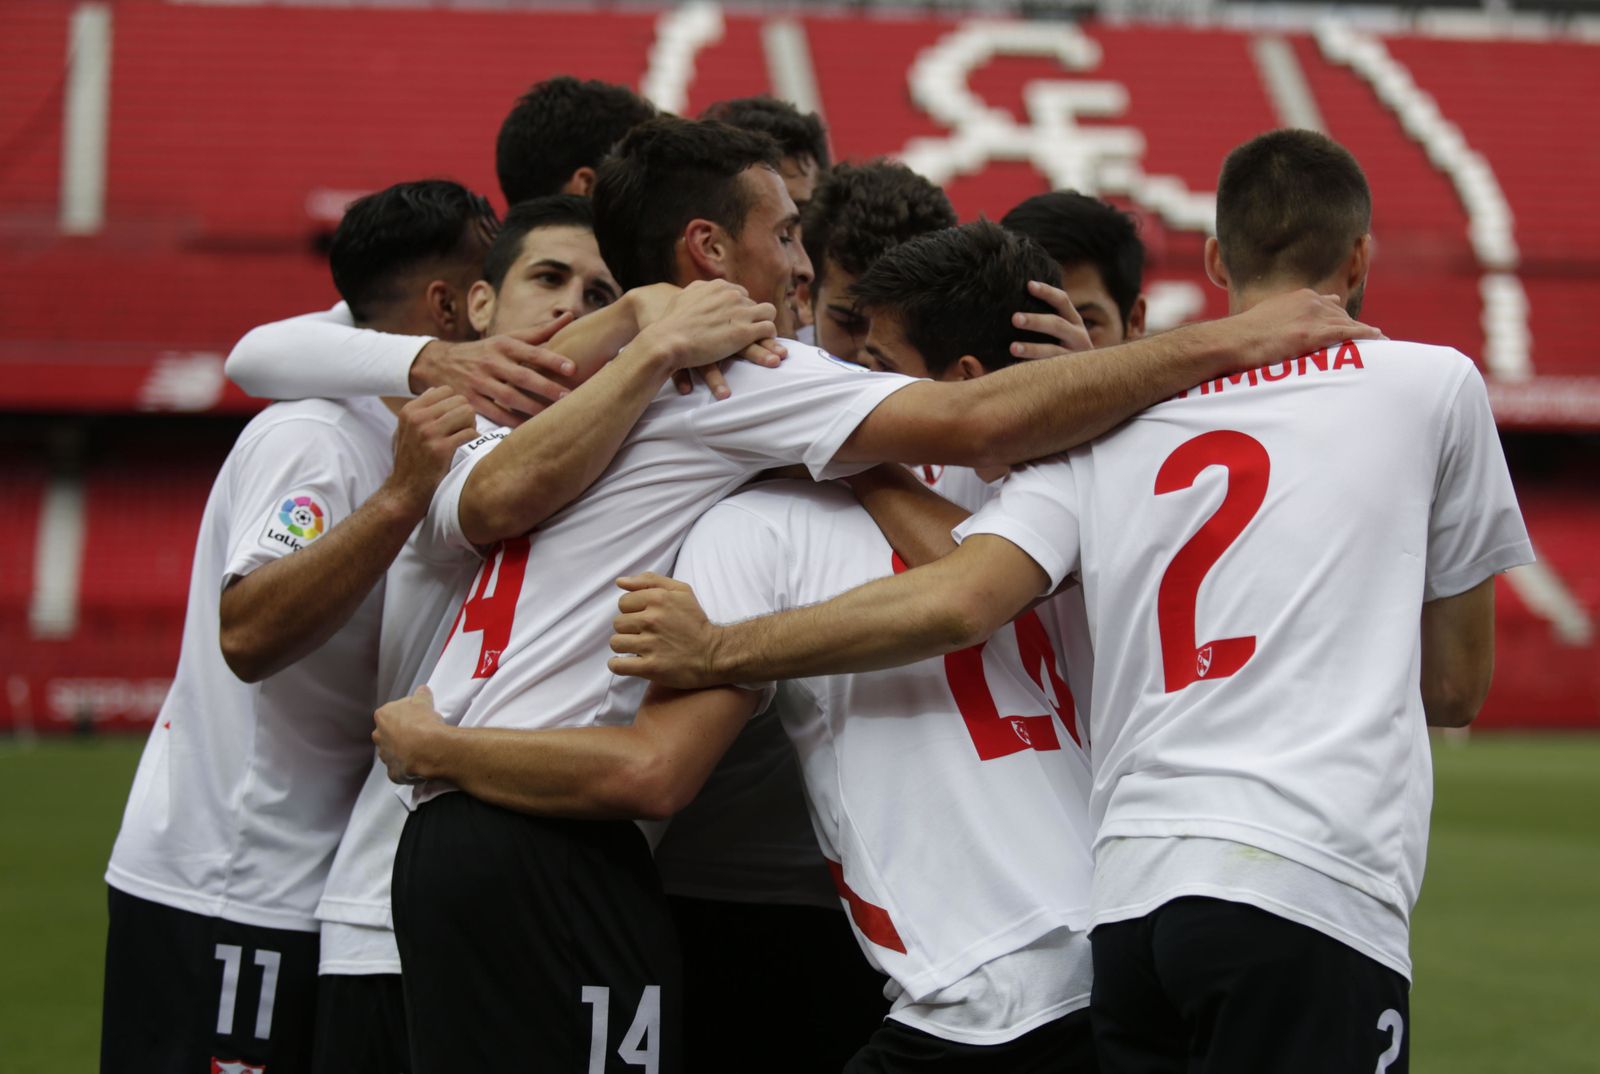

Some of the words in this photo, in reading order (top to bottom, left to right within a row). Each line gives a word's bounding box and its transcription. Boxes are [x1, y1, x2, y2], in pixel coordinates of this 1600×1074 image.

[1154, 429, 1271, 694] 2
[214, 943, 282, 1040] 11
[581, 985, 661, 1074] 14
[1376, 1008, 1404, 1074] 2
